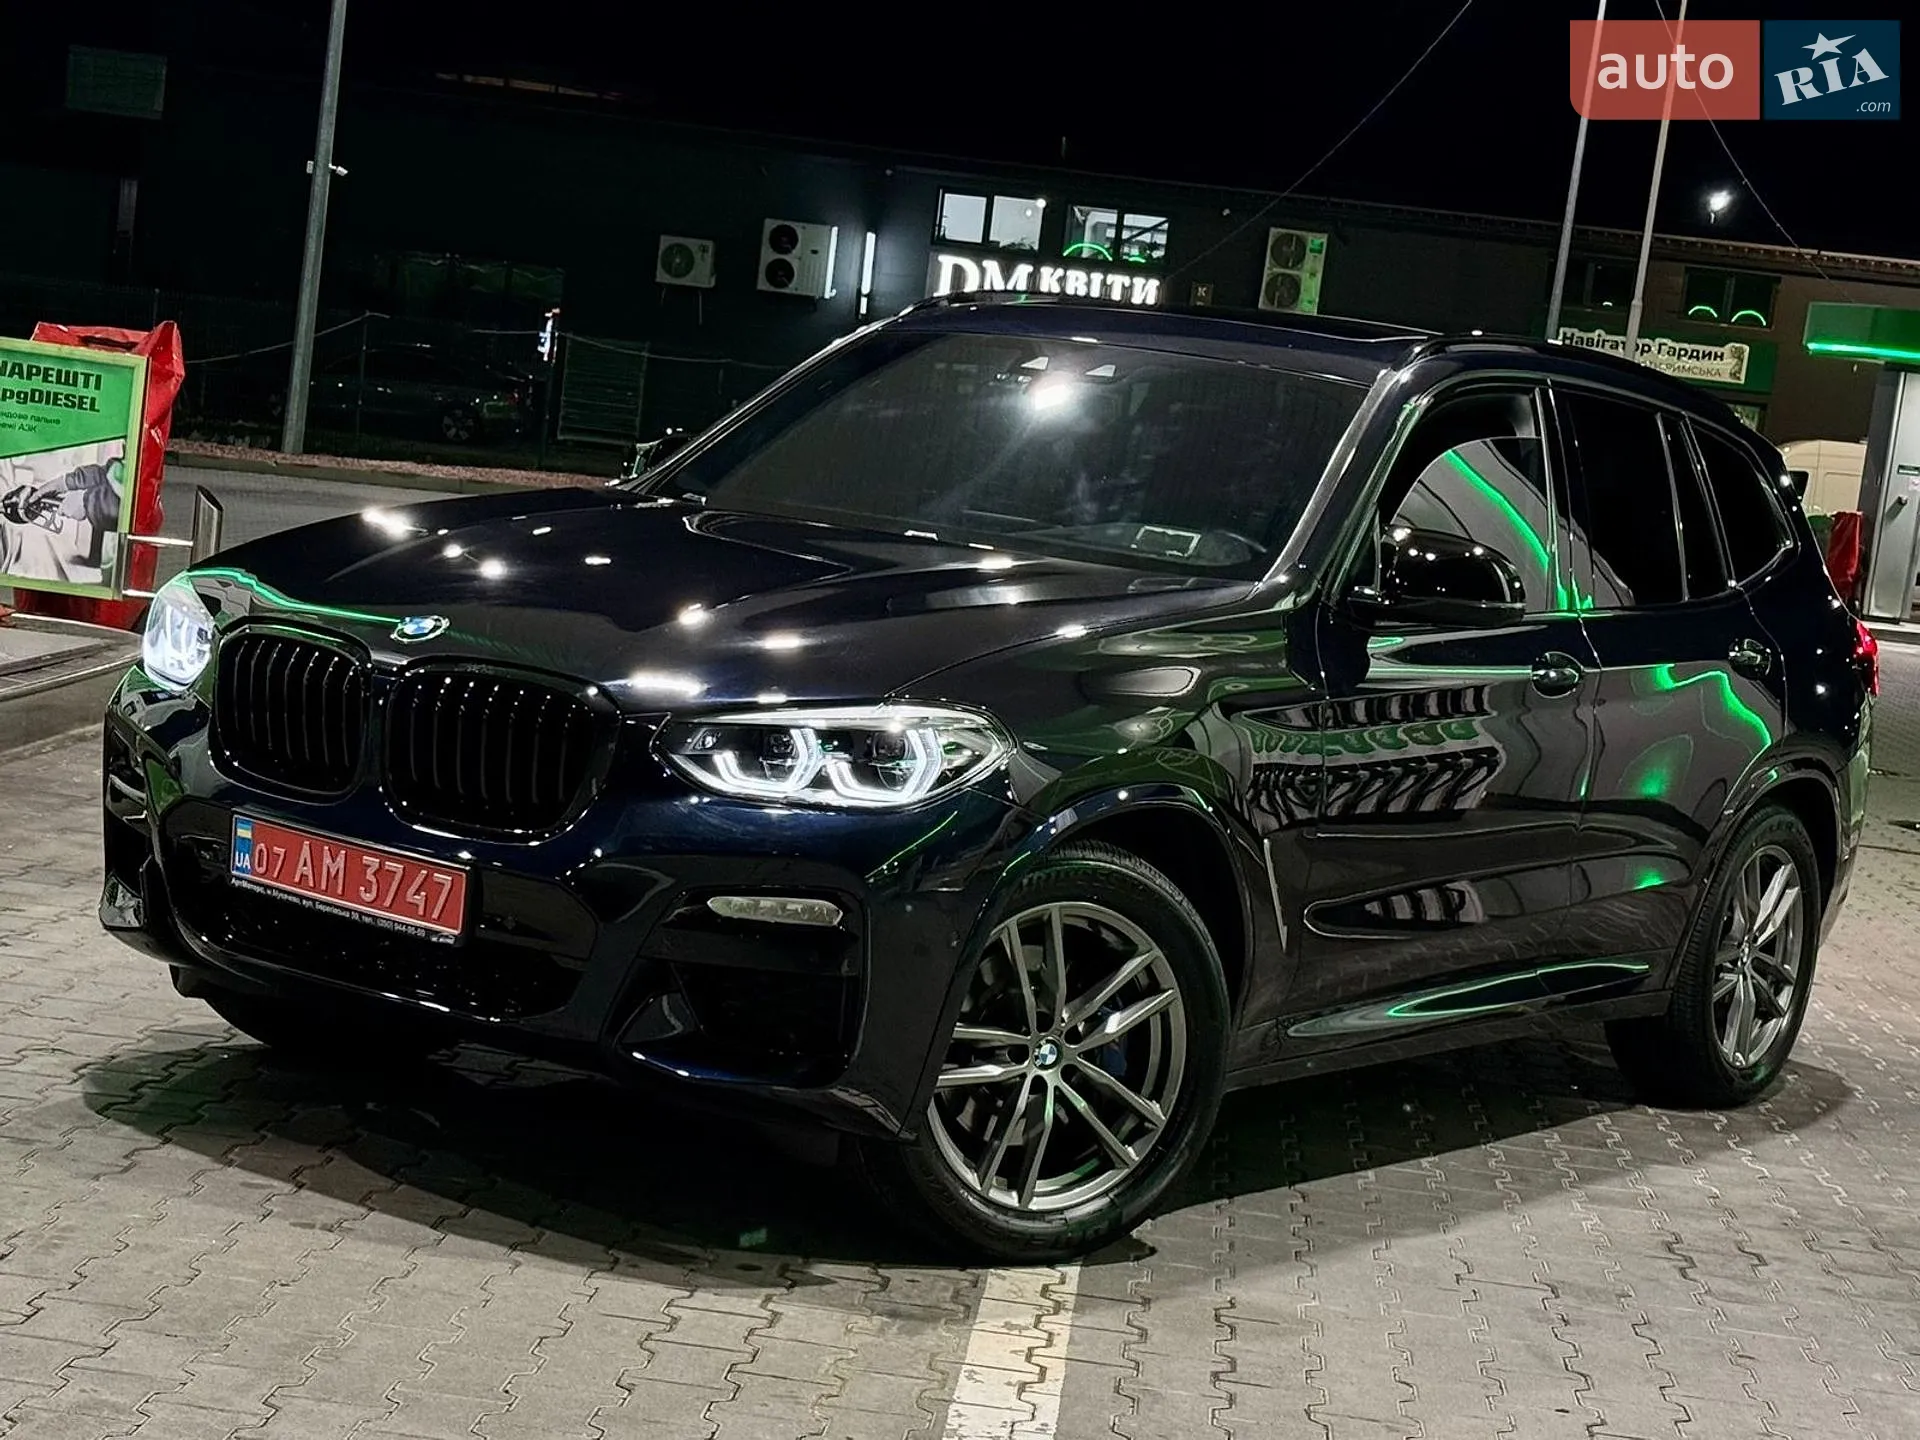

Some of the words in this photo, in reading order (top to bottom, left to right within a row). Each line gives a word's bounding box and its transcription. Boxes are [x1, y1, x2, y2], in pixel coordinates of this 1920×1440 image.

[933, 254, 1033, 297] DM
[1039, 265, 1161, 306] КВІТИ
[1657, 342, 1726, 361] Гардин
[236, 851, 251, 870] UA
[254, 843, 287, 880] 07
[360, 855, 453, 921] 3747
